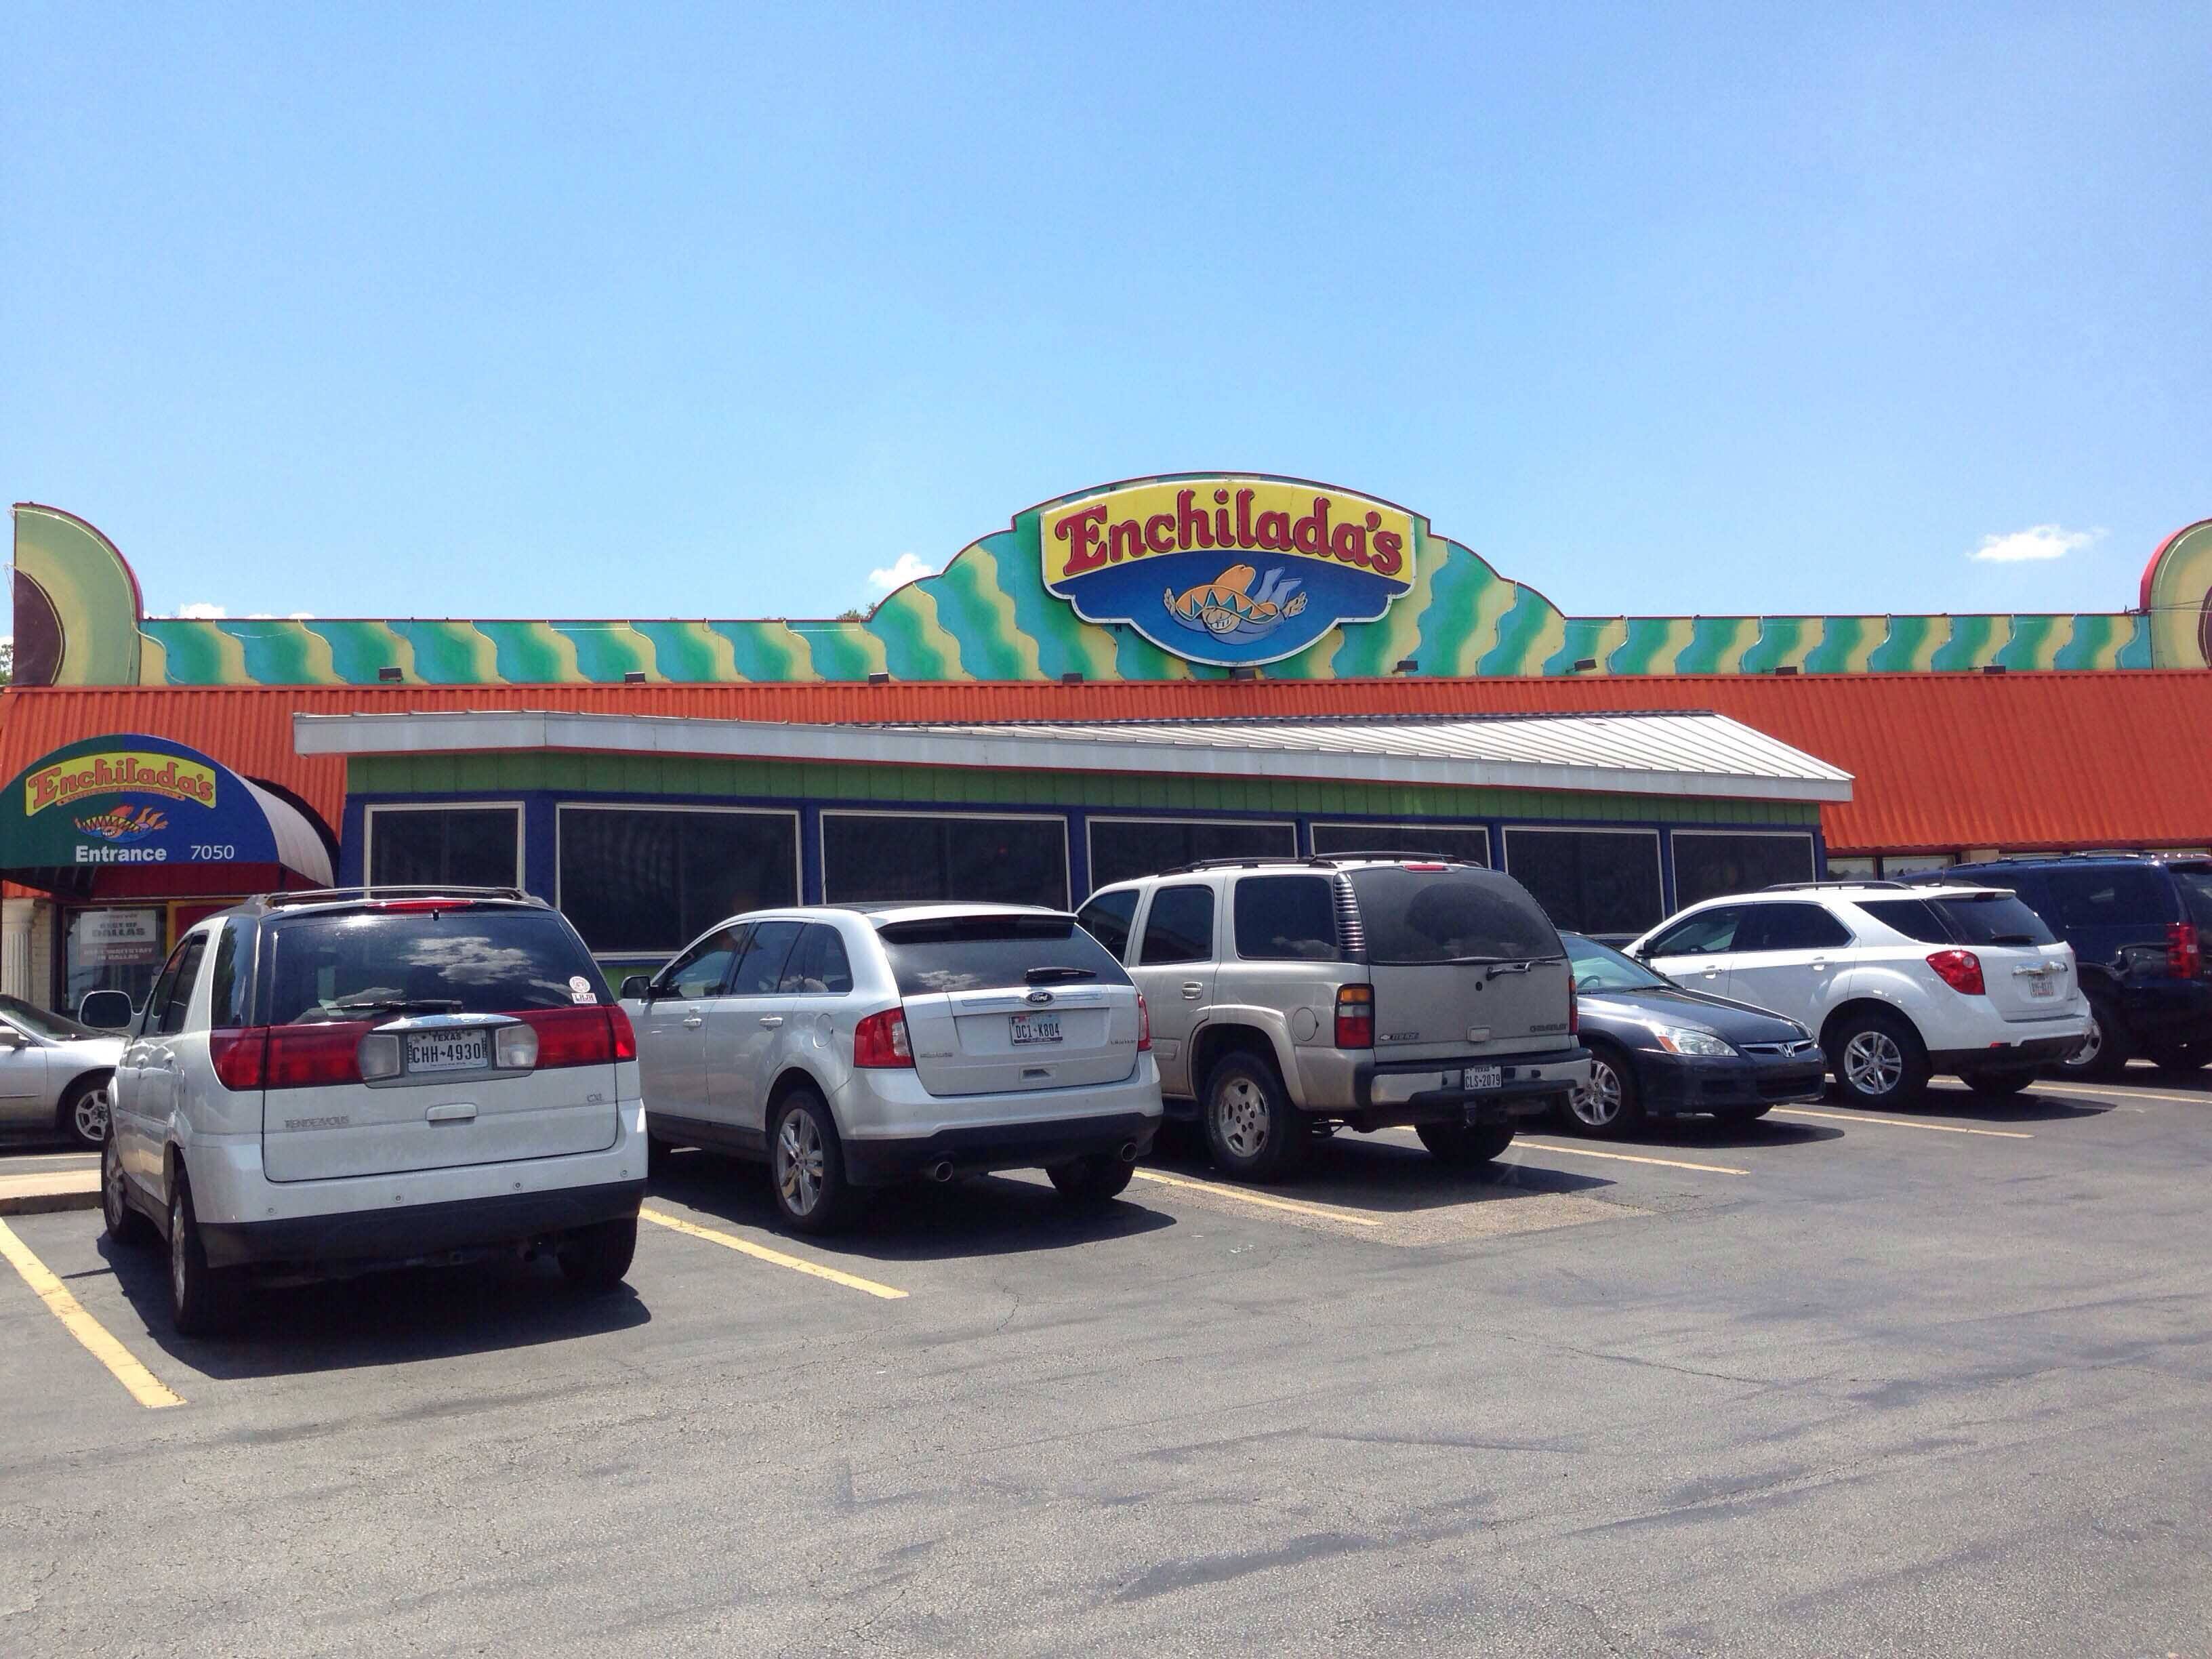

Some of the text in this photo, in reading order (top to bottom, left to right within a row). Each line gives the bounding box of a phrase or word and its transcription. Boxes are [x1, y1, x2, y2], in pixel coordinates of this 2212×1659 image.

[1054, 488, 1403, 576] Enchilada's
[28, 758, 213, 809] Enchilada's
[75, 844, 235, 862] Entrance 7050
[92, 928, 146, 937] DALLAS
[1031, 994, 1048, 1002] Ford
[433, 1033, 462, 1042] TEXAS
